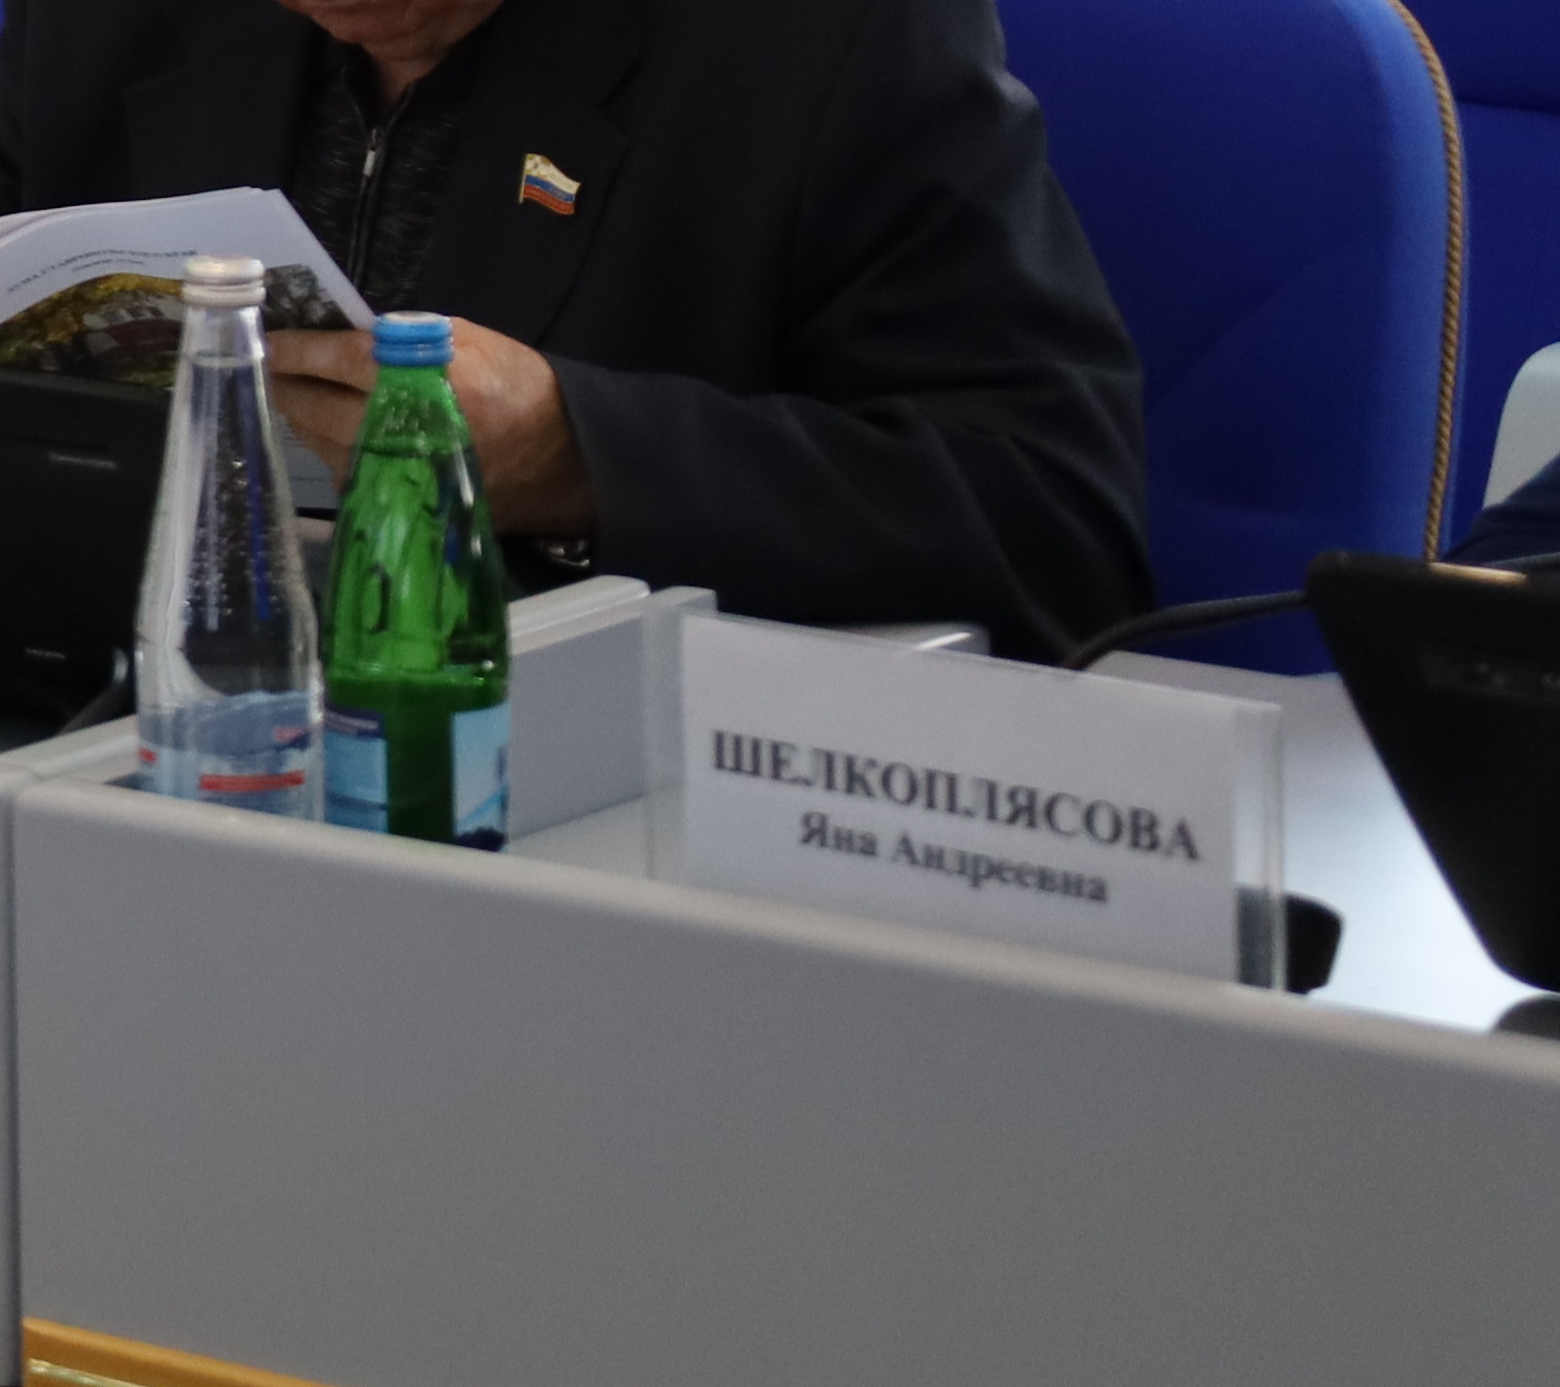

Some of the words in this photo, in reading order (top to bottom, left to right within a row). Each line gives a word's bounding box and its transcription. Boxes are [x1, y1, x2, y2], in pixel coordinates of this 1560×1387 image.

[713, 730, 1202, 862] ШЕЛКОПЛЯСОВА
[800, 811, 880, 858] Яна
[890, 831, 1110, 903] Андреевна
